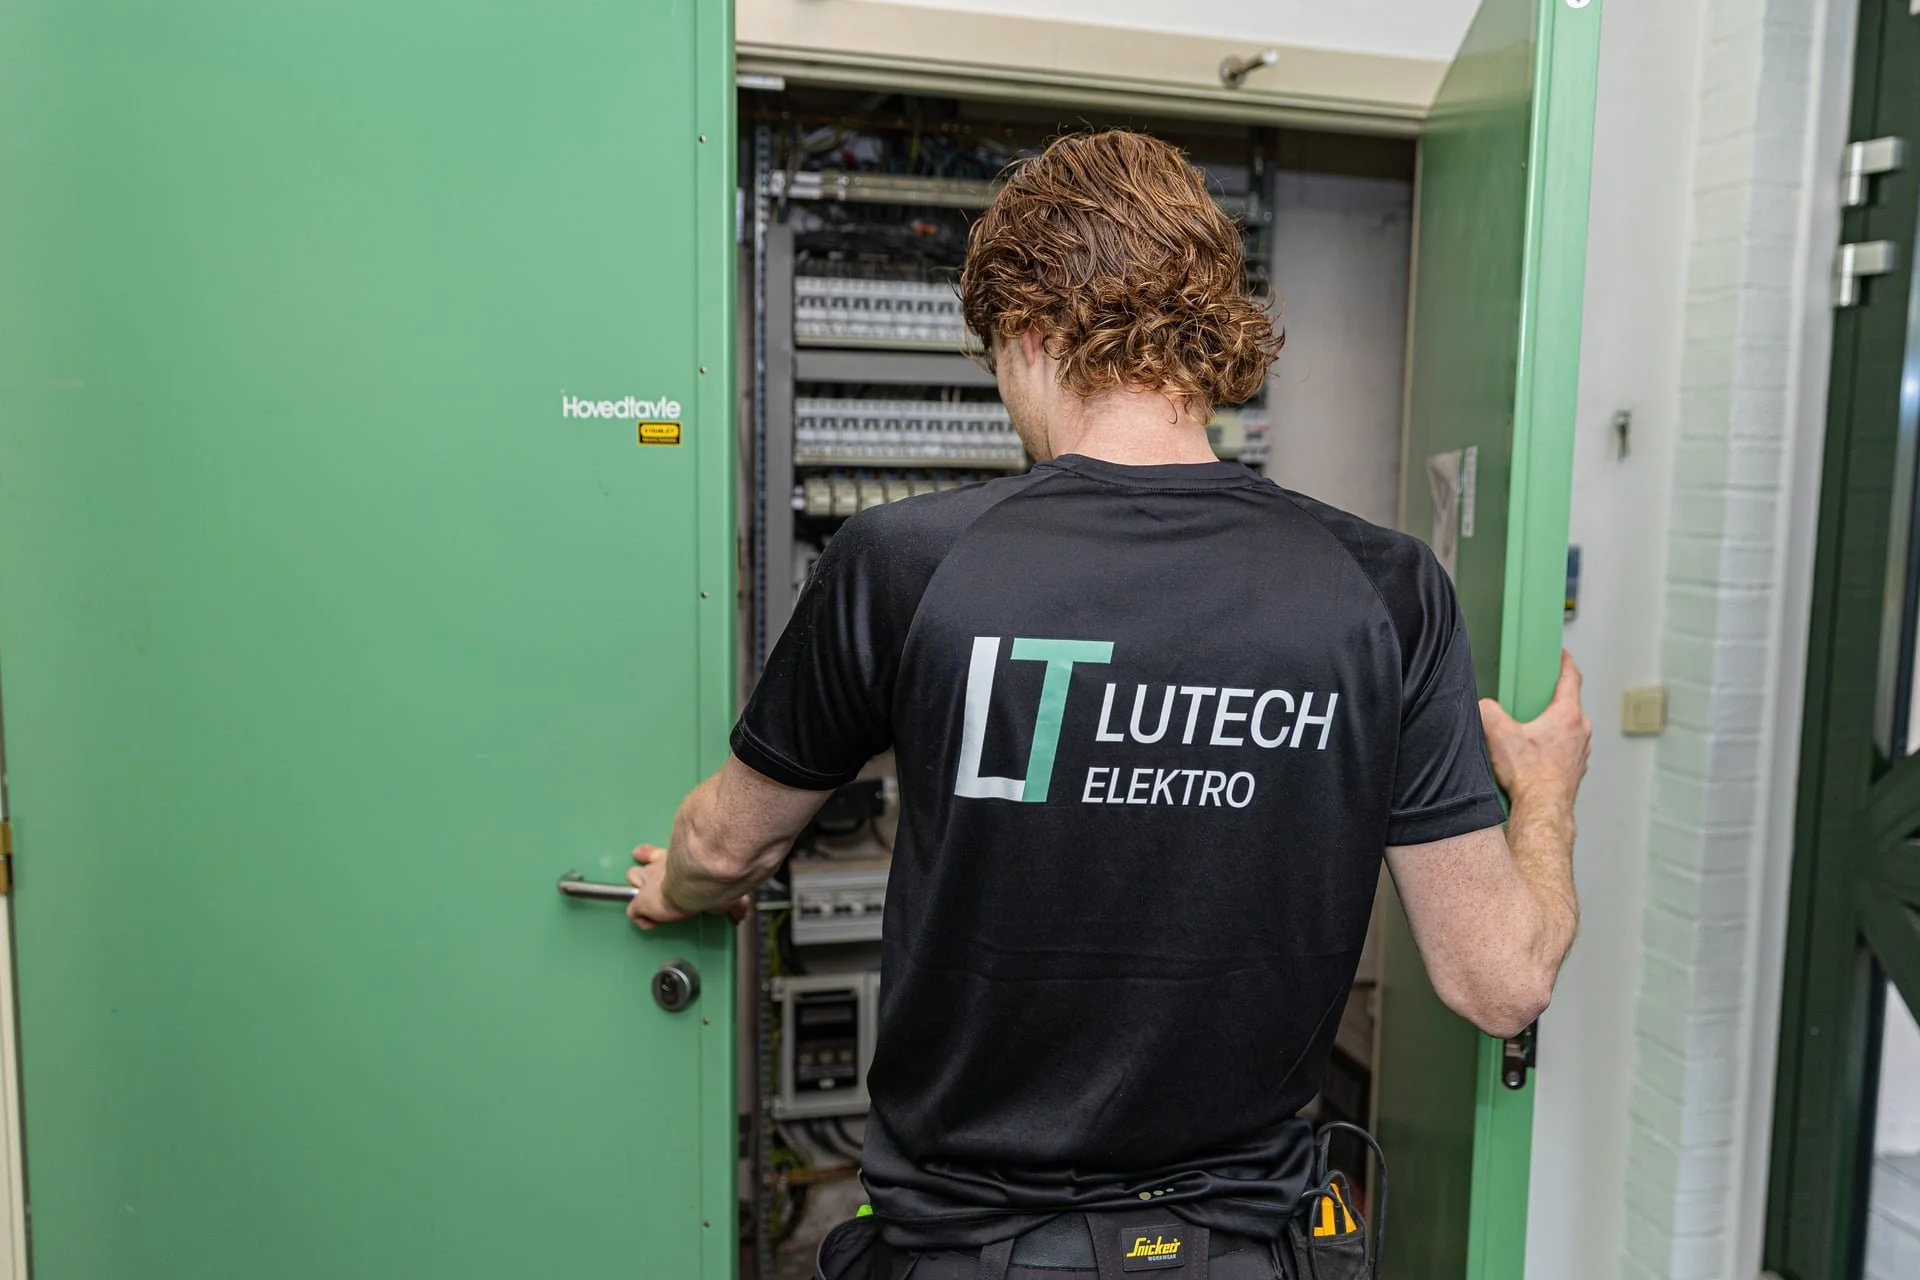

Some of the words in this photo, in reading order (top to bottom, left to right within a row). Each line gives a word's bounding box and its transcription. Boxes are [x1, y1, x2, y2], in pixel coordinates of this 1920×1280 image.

[562, 395, 681, 419] Hovedtavle
[954, 636, 1115, 803] LT
[1095, 682, 1339, 750] LUTECH
[1081, 766, 1256, 809] ELEKTRO
